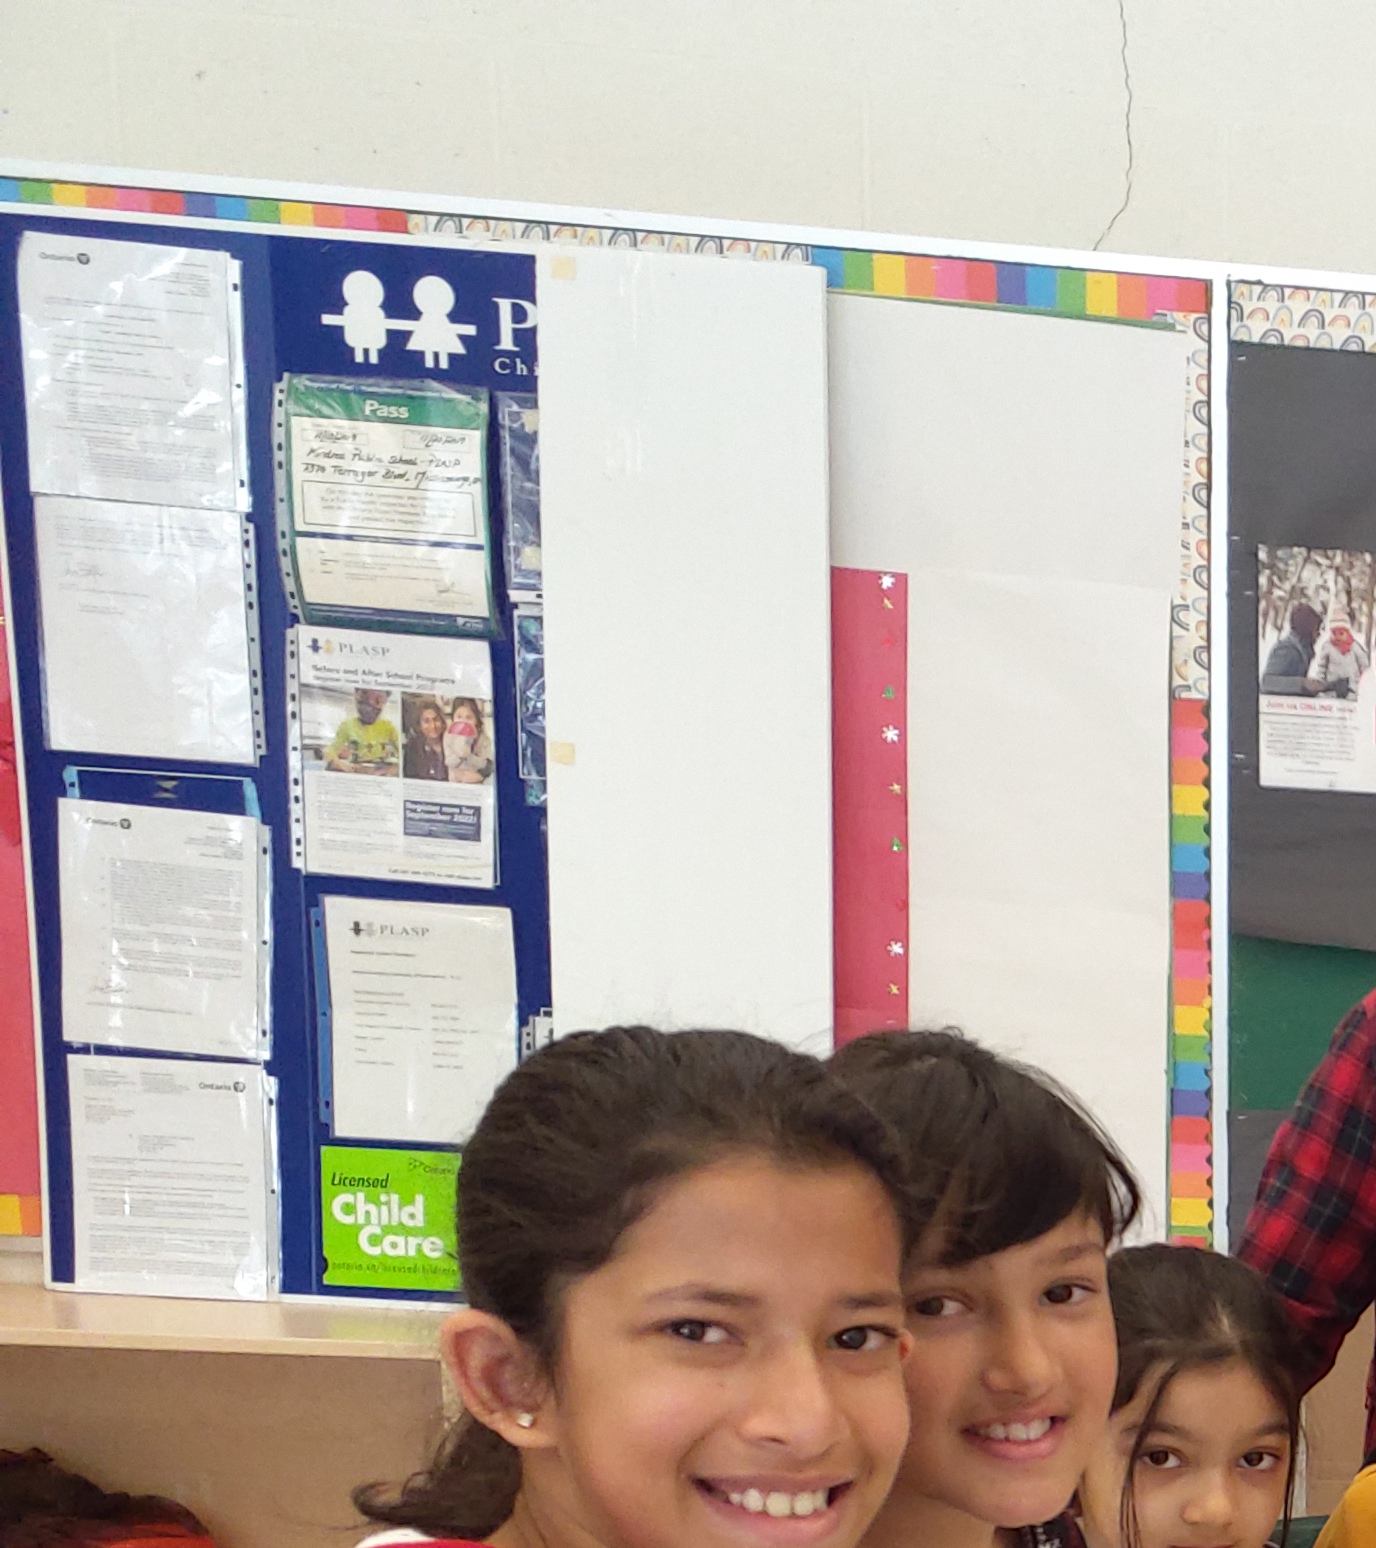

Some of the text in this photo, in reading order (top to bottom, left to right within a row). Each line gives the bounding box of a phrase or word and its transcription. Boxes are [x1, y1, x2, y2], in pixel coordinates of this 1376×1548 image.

[364, 399, 410, 418] Pass
[338, 641, 391, 657] PLASP
[379, 923, 431, 937] PLASP
[330, 1171, 390, 1189] Licensed
[331, 1191, 425, 1228] Child
[357, 1224, 445, 1259] Care
